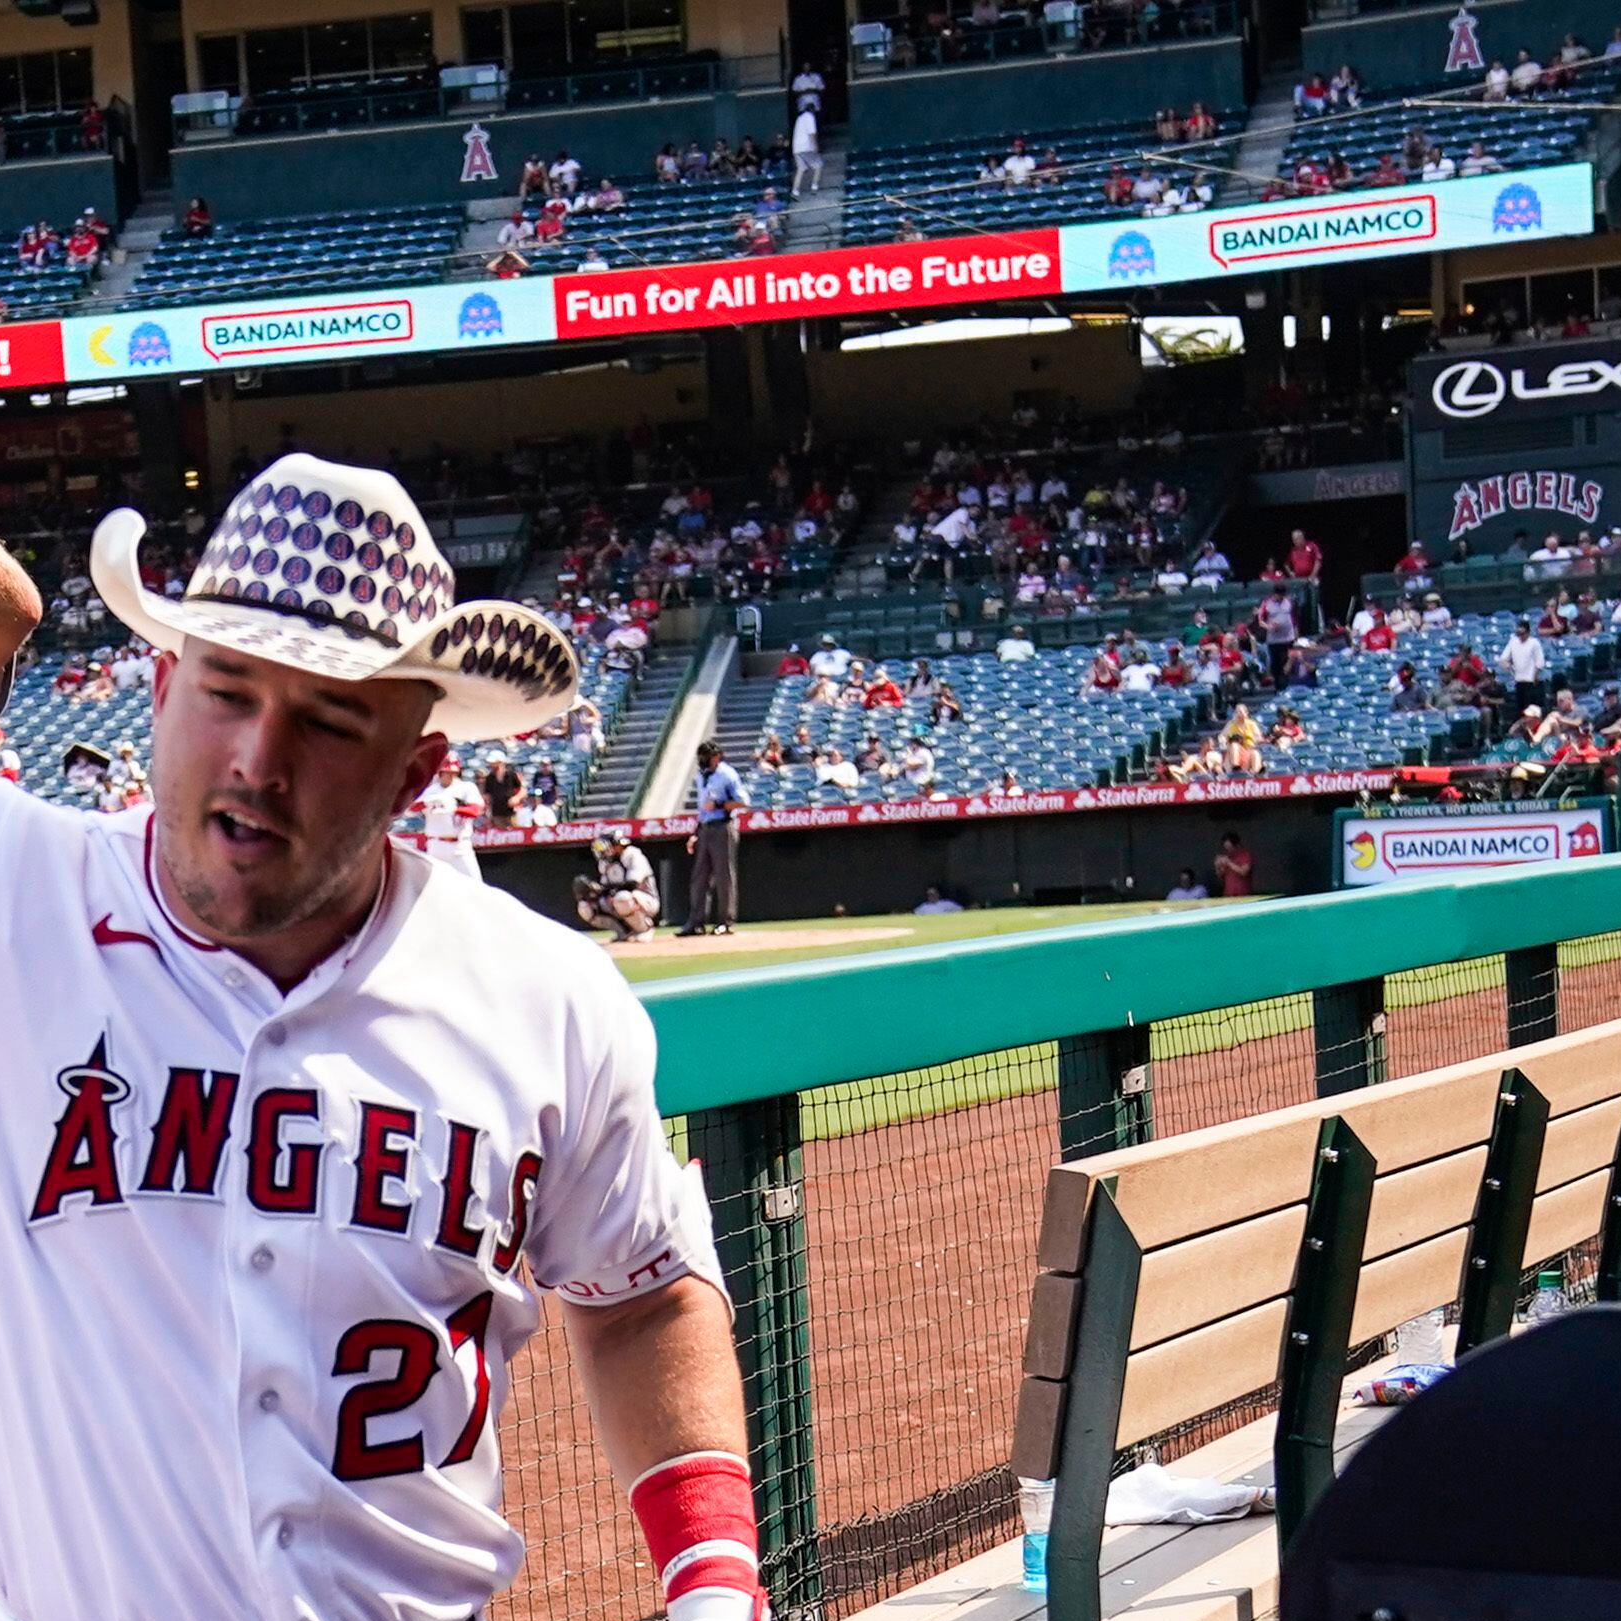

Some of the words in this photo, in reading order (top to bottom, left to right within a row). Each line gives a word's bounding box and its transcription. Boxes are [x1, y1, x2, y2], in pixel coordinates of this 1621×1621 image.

[1222, 224, 1319, 252] BANDAI
[1324, 208, 1424, 239] NAMCO
[566, 290, 637, 322] Fun
[644, 283, 701, 315] for
[706, 275, 756, 309] All
[765, 271, 841, 304] into
[847, 262, 912, 295] the
[920, 253, 1051, 289] Future
[214, 320, 304, 346] BANDAI
[310, 312, 401, 337] NAMCO
[1447, 471, 1603, 542] ANGELS
[989, 794, 1066, 814] StateFarm
[1097, 786, 1177, 808] StateFarm
[1205, 779, 1281, 801] StateFarm
[881, 802, 958, 822] StateFarm
[1393, 841, 1466, 859] BANDAI
[1471, 835, 1549, 855] NAMCO
[27, 1017, 547, 1277] ANGELS
